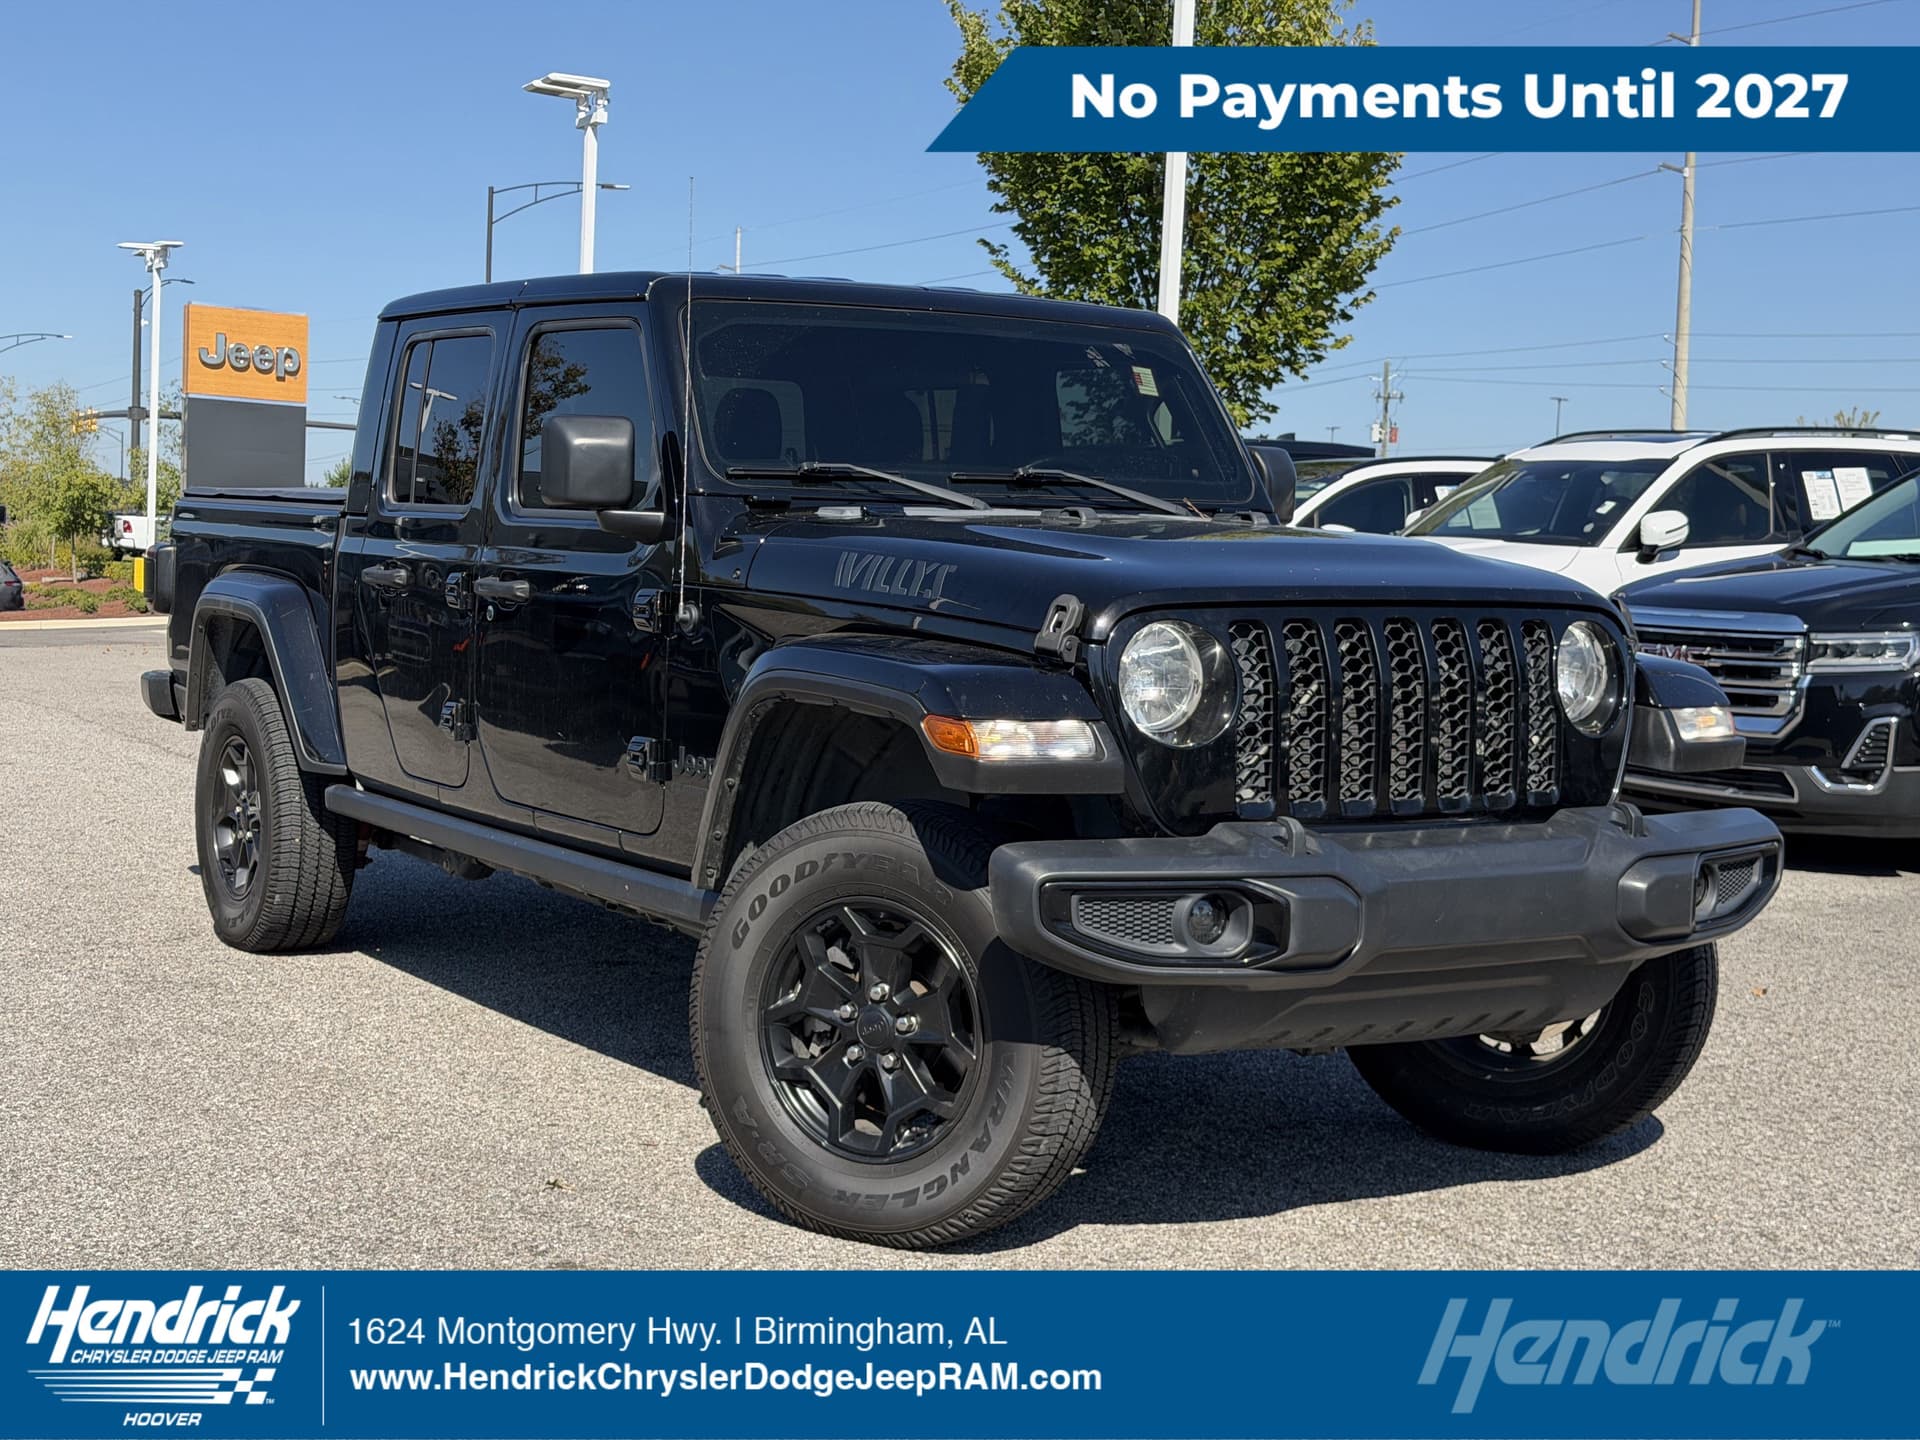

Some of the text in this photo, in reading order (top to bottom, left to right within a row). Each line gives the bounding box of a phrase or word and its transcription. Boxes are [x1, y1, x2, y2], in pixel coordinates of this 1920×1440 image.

[198, 332, 301, 382] Jeep
[834, 551, 958, 602] WILLYS
[831, 1052, 1017, 1211] WRANGLER
